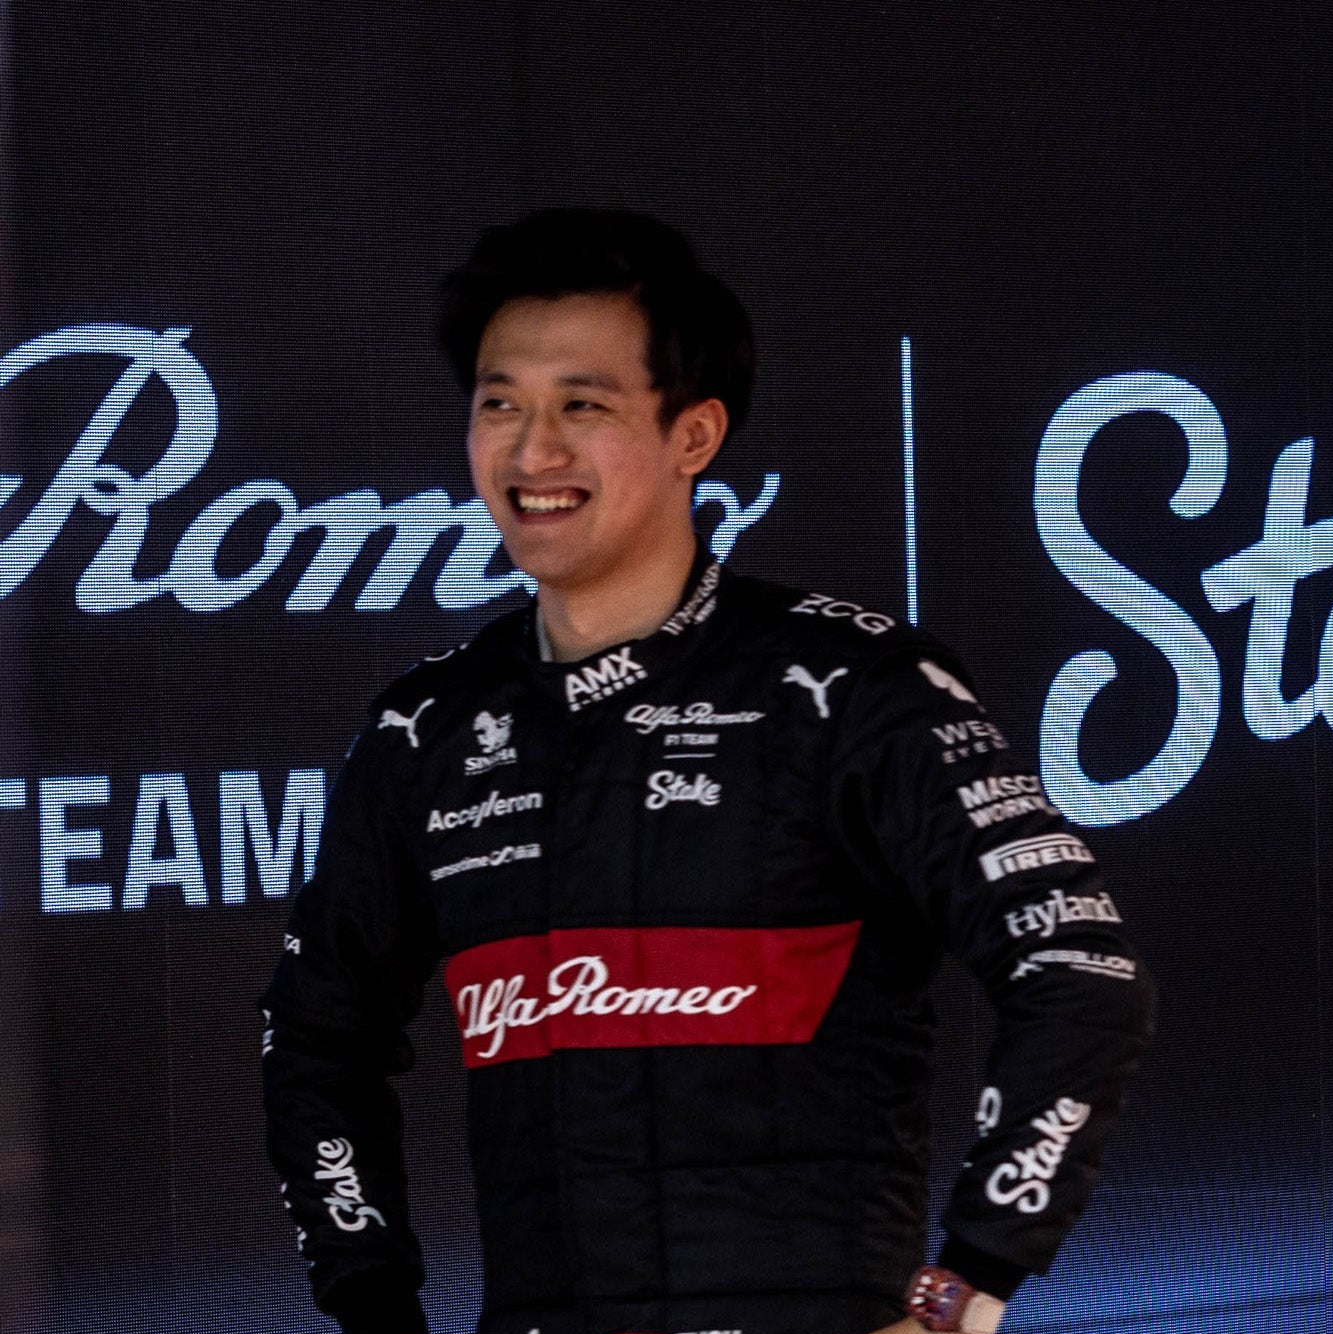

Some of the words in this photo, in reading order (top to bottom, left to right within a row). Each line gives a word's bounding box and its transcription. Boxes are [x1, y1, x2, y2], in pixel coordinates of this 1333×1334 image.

[0, 322, 781, 613] Rom
[789, 594, 896, 635] ZCG
[564, 646, 644, 703] AMX
[646, 769, 722, 810] Stake
[1004, 889, 1124, 937] Hyland
[547, 955, 757, 1017] Romeo
[314, 1137, 387, 1233] Stake
[985, 1096, 1093, 1215] Stake
